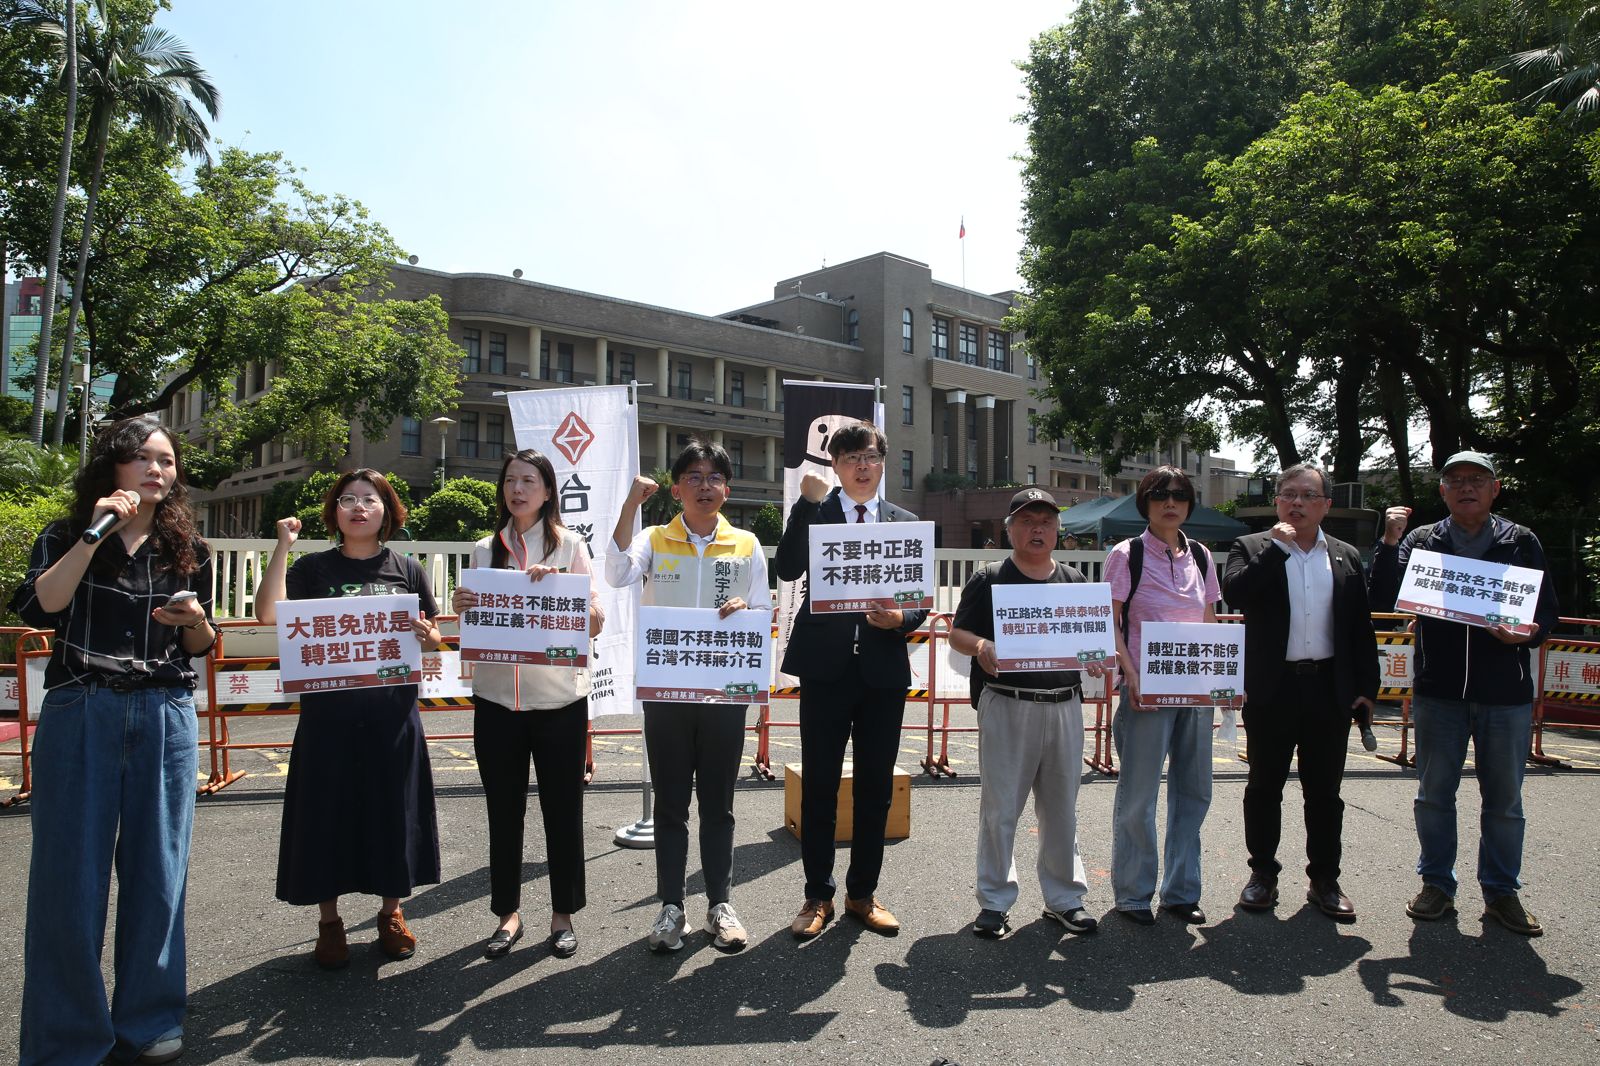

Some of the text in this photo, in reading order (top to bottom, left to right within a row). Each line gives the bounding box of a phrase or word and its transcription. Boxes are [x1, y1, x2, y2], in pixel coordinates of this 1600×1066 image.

[822, 539, 923, 561] 不要中正路
[822, 563, 924, 586] 不拜蔣光頭
[1411, 564, 1536, 595] 中正路改名不能停
[1414, 577, 1525, 607] 威權象徵不要留
[837, 602, 867, 610] 台灣基進
[996, 605, 1111, 620] 中正路改名卓榮泰喊停
[1421, 606, 1455, 619] 台灣基進
[286, 610, 412, 640] 大罷免就是
[464, 610, 586, 632] 轉型正義不能逃避
[1002, 621, 1106, 635] 轉型正義不應有假期
[646, 628, 763, 649] 德國不拜希特勒
[301, 638, 402, 666] 轉型正義
[486, 652, 518, 661] 台灣基進
[646, 648, 763, 669] 台灣不拜蔣介石
[1147, 642, 1239, 658] 轉型正義不能停
[1147, 660, 1238, 676] 威權象徵不要留
[1385, 652, 1408, 678] 道
[312, 679, 347, 689] 台灣基進
